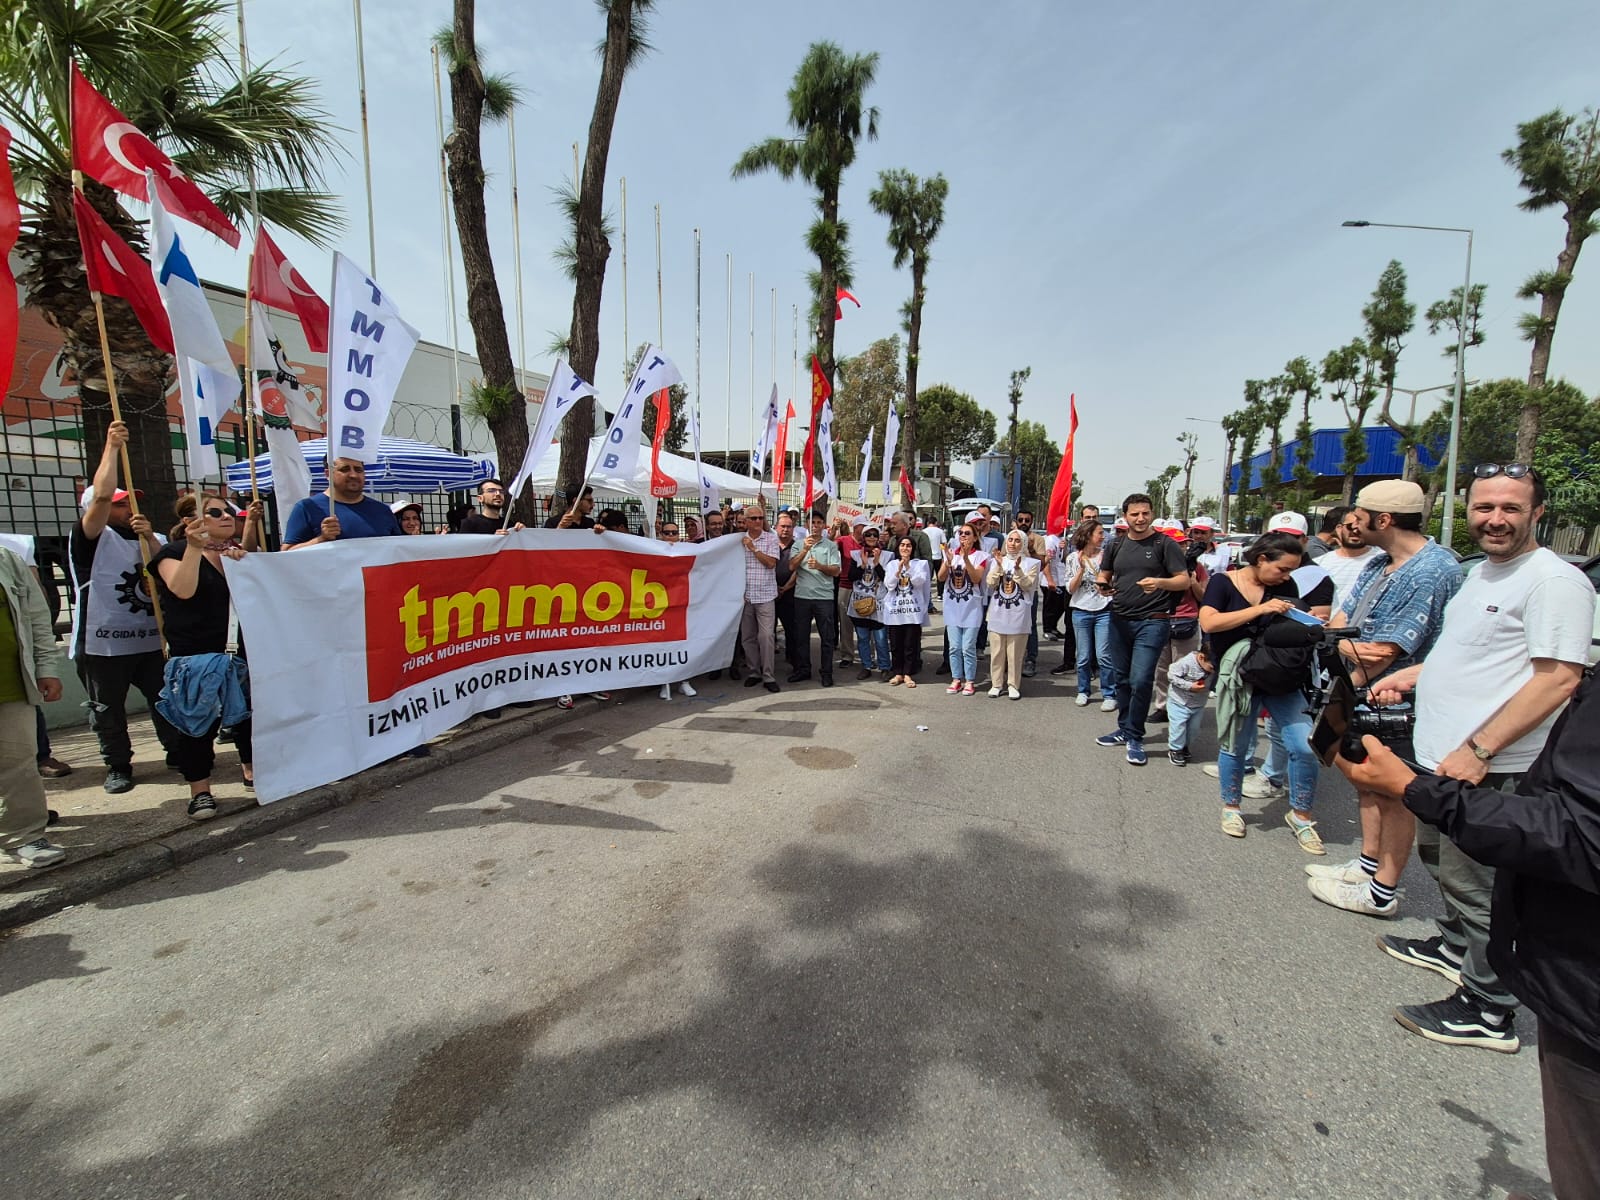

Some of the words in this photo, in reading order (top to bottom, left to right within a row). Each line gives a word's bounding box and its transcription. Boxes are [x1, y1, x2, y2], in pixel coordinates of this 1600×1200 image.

[96, 628, 110, 639] ÖZ
[112, 629, 136, 639] GIDA
[398, 568, 669, 654] tmmob
[402, 652, 435, 674] TÜRK
[436, 634, 502, 661] MÜHENDİS
[505, 631, 523, 643] VE
[525, 625, 569, 641] MİMAR
[571, 622, 621, 637] ODALARI
[624, 618, 666, 633] BİRLİĞİ
[368, 697, 429, 738] İZMİR
[432, 688, 450, 711] İL
[455, 656, 613, 700] KOORDİNASYON
[618, 650, 690, 672] KURULU
